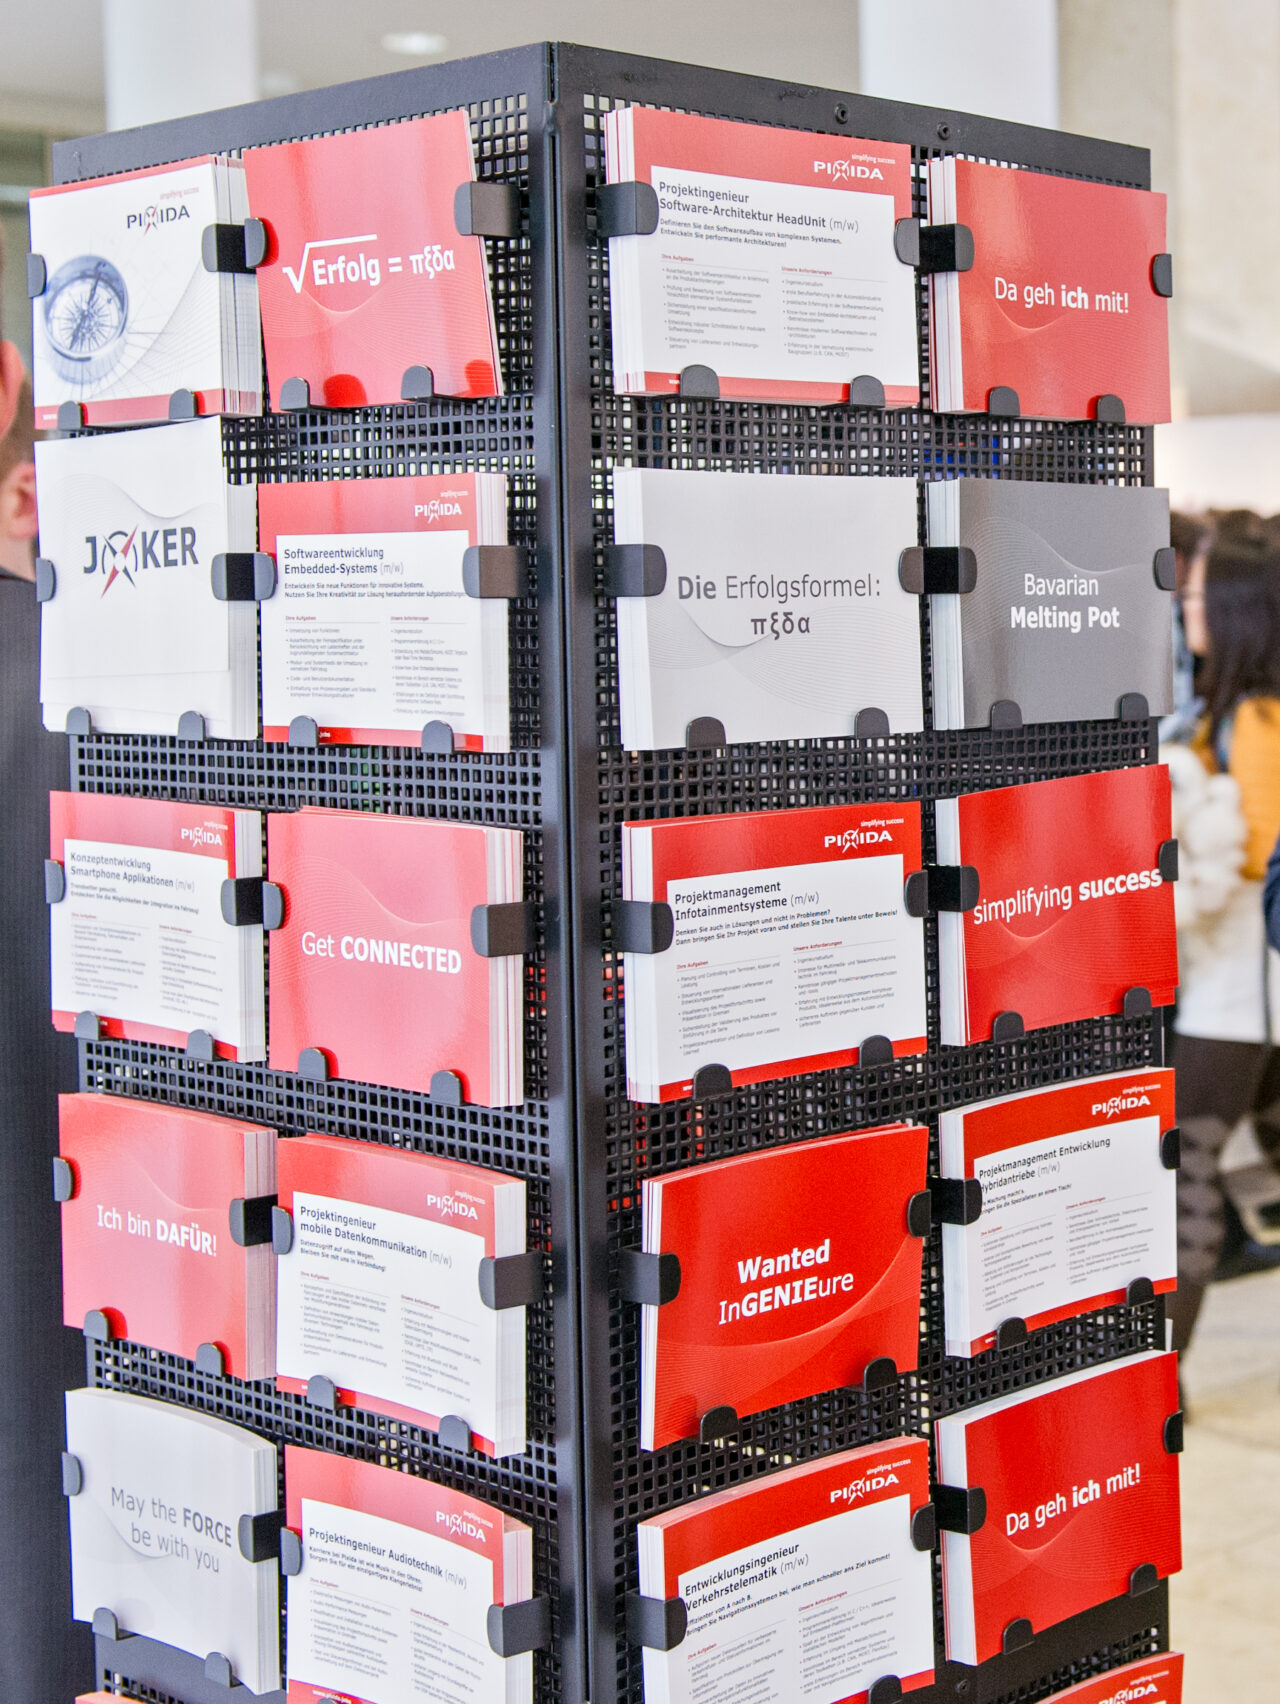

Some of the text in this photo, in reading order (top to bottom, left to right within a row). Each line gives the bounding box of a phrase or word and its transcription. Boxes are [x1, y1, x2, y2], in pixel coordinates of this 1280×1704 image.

[659, 181, 749, 203] Projektingenieur
[659, 198, 859, 234] Software-Architektur HeadUnit (m/w)
[409, 244, 456, 279] πξδα
[994, 276, 1129, 314] Da geh ich mit!
[284, 547, 384, 560] Softwareentwicklung
[284, 563, 378, 576] Embedded-Systems
[677, 573, 881, 604] Die Erfolgsformel:
[1024, 573, 1099, 596] Bavarian
[750, 611, 811, 640] πξδα
[1010, 605, 1120, 633] Melting Pot
[70, 866, 120, 880] Smartphone
[122, 872, 174, 888] Applikationen
[71, 852, 151, 872] Konzeptentwicklung
[675, 882, 782, 905] Projektmanagement
[675, 891, 820, 921] Infotainmentsysteme (m/w)
[973, 868, 1163, 925] simplifying success
[675, 928, 697, 937] Denken
[709, 924, 723, 932] auch
[732, 919, 760, 929] Lösungen
[774, 915, 788, 923] nicht
[796, 909, 831, 919] Problemen?
[675, 938, 691, 946] Dann
[693, 935, 715, 943] bringen
[737, 928, 759, 937] Projekt
[790, 921, 810, 929] stellen
[835, 915, 857, 923] Talente
[875, 909, 898, 918] Beweis!
[301, 931, 462, 974] Get CONNECTED
[979, 1137, 1111, 1179] Projektmanagement Entwicklung
[1037, 1161, 1061, 1178] (m/w)
[96, 1205, 217, 1257] Ich bin DAFÜR!
[300, 1206, 376, 1230] Projektingenieur
[300, 1223, 452, 1268] mobile Datenkommunikation (m/w)
[737, 1238, 831, 1284] Wanted
[718, 1272, 854, 1325] InGENIEure
[111, 1486, 232, 1548] May the FORCE
[1006, 1463, 1140, 1536] Da geh ich mit!
[131, 1522, 220, 1573] be with you
[309, 1527, 467, 1589] Projektingenieur Audiotechnik (m/w)
[685, 1543, 800, 1597] Entwicklungsingenieur
[685, 1553, 809, 1612] Verkehrstelematik (m/w)
